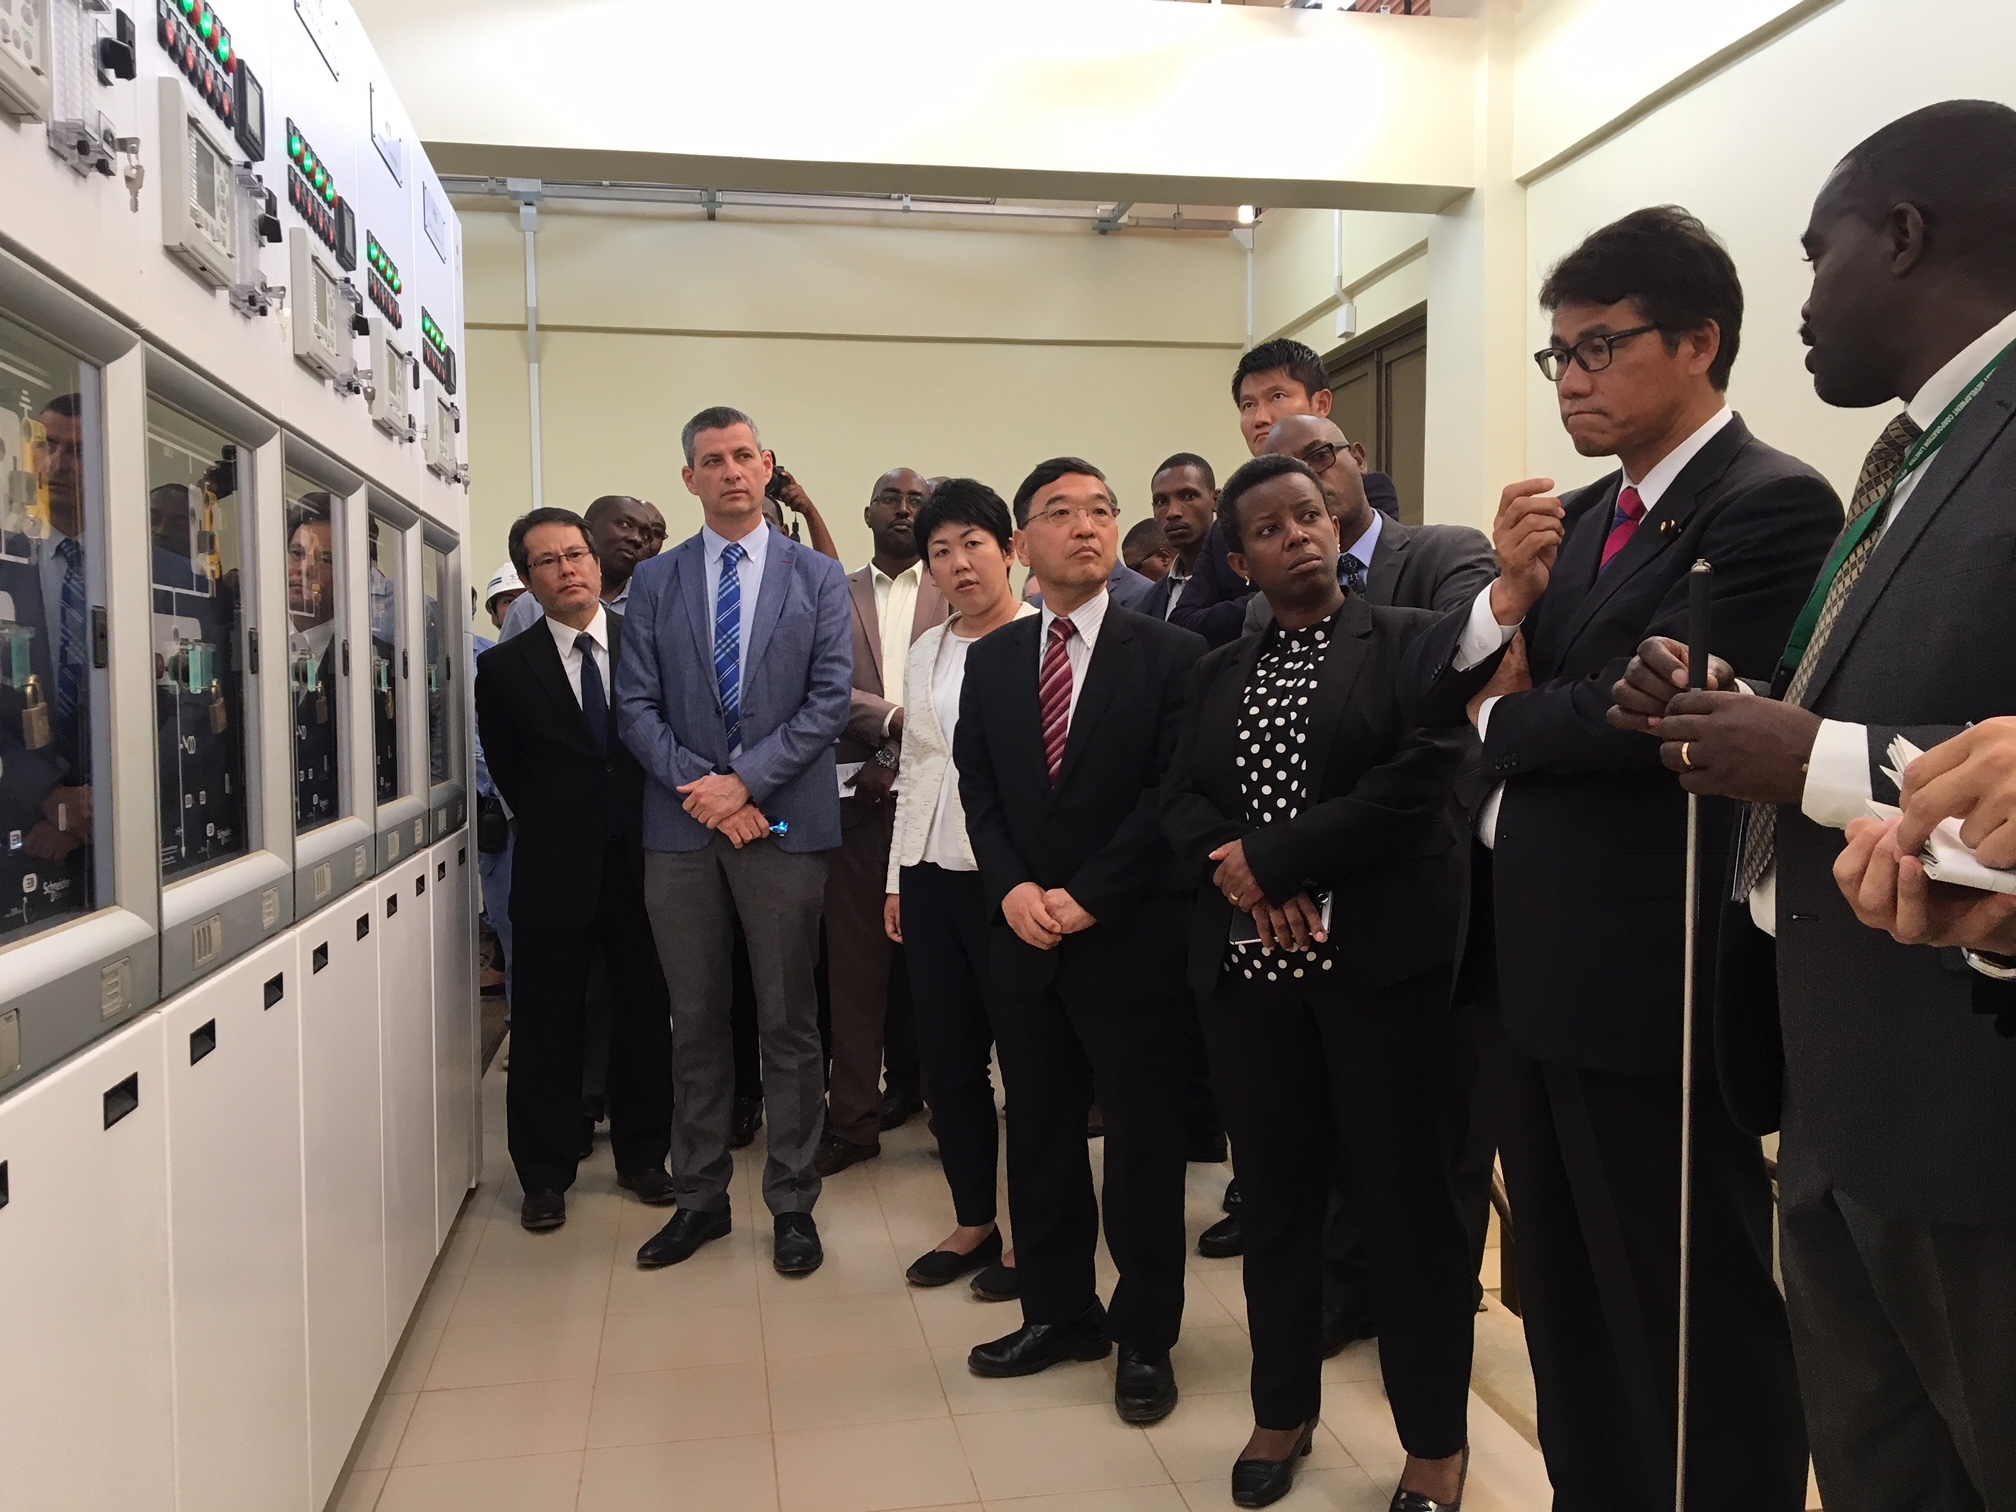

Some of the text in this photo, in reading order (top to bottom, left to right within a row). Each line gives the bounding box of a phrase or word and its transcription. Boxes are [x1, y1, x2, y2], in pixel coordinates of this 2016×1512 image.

[1909, 381, 1985, 466] DEVELOPMENT CORPORATION LIMITED
